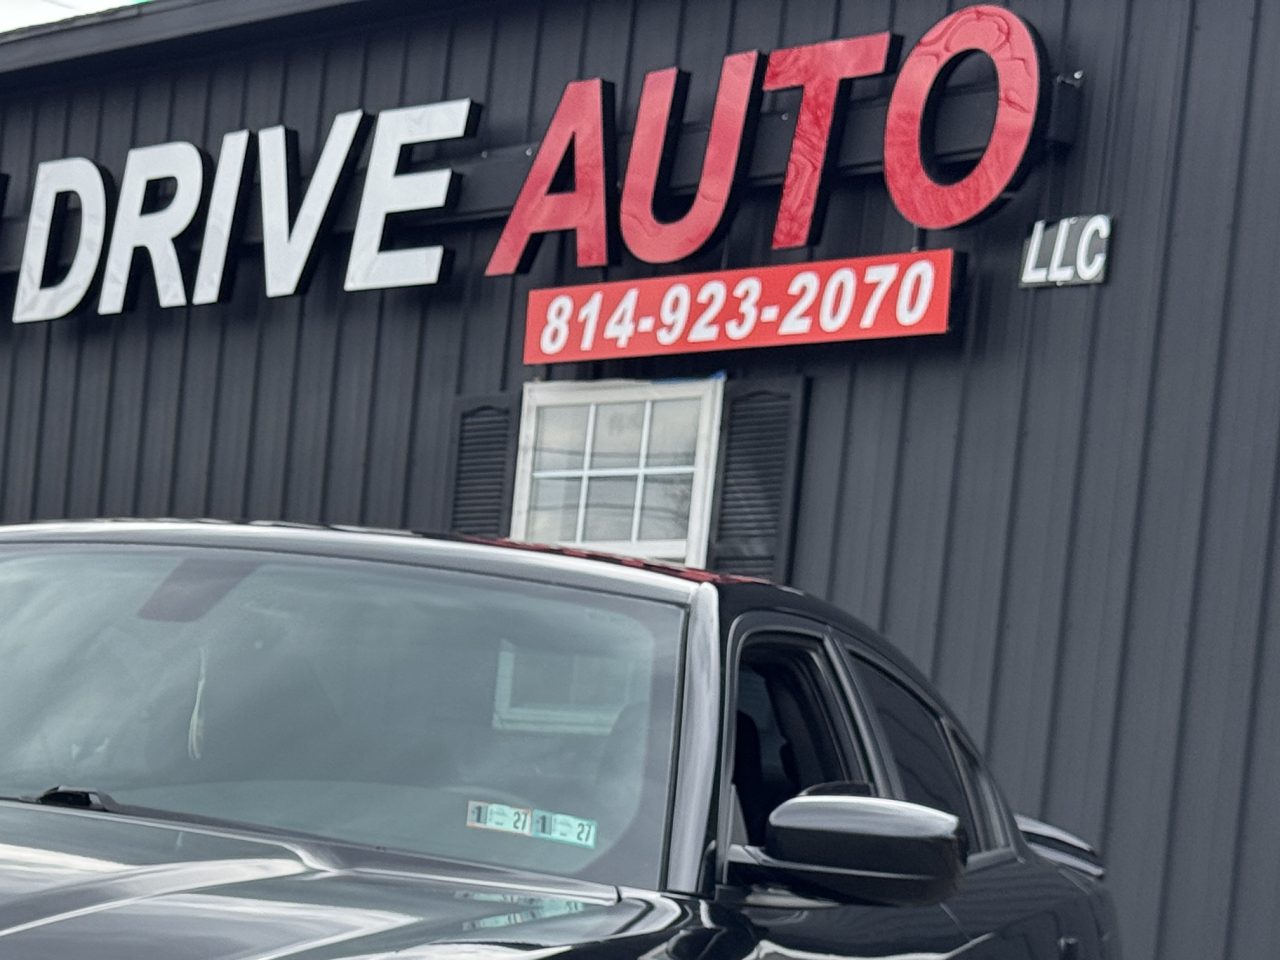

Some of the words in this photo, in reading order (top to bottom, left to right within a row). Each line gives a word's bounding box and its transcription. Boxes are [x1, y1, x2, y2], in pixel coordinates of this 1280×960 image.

[12, 98, 471, 323] DRIVE
[484, 4, 1040, 276] AUTO
[1022, 214, 1111, 283] LLC
[540, 260, 935, 355] 814-923-2070
[513, 811, 528, 831] 27
[576, 823, 592, 843] 27
